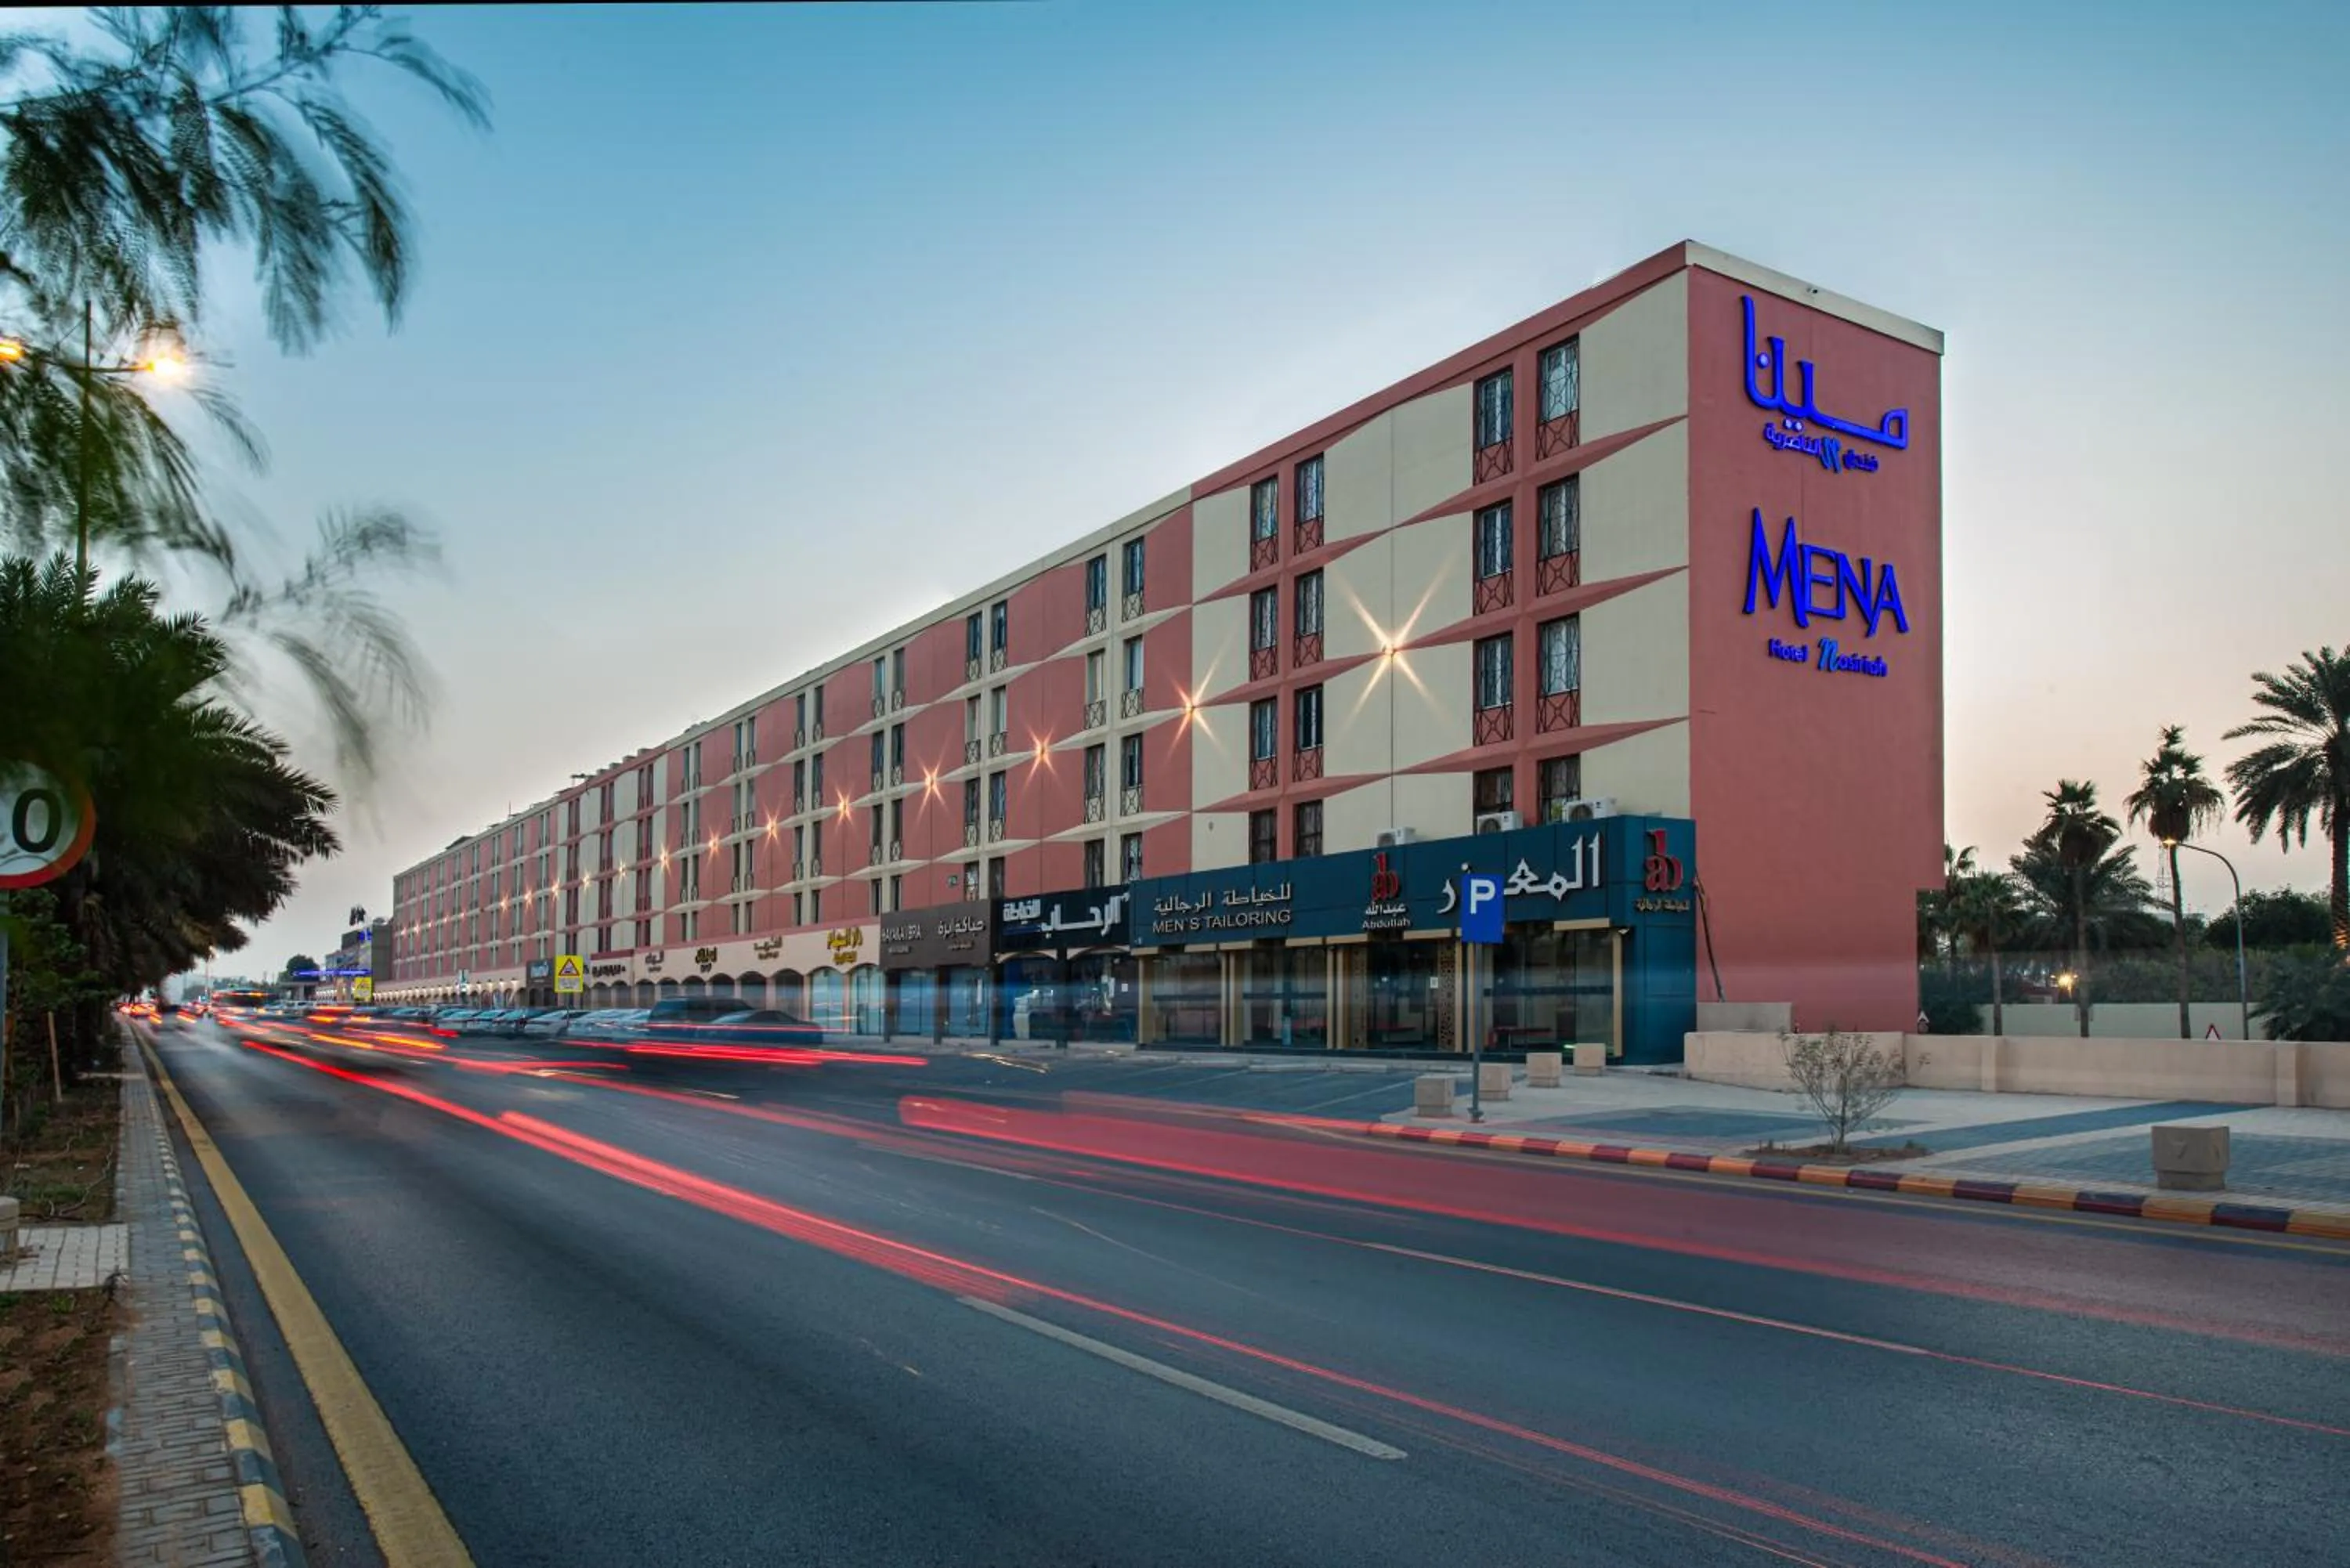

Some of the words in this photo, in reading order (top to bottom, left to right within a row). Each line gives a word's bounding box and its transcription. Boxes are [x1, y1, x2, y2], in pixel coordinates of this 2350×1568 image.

[1742, 507, 1909, 638] MENA
[1768, 638, 1808, 663] Hotel
[1153, 891, 1212, 916] الرجالية
[1221, 881, 1291, 907] للخياطة
[1470, 878, 1495, 915] P
[1205, 909, 1291, 928] TAILORING
[1362, 917, 1412, 930] Abdullah
